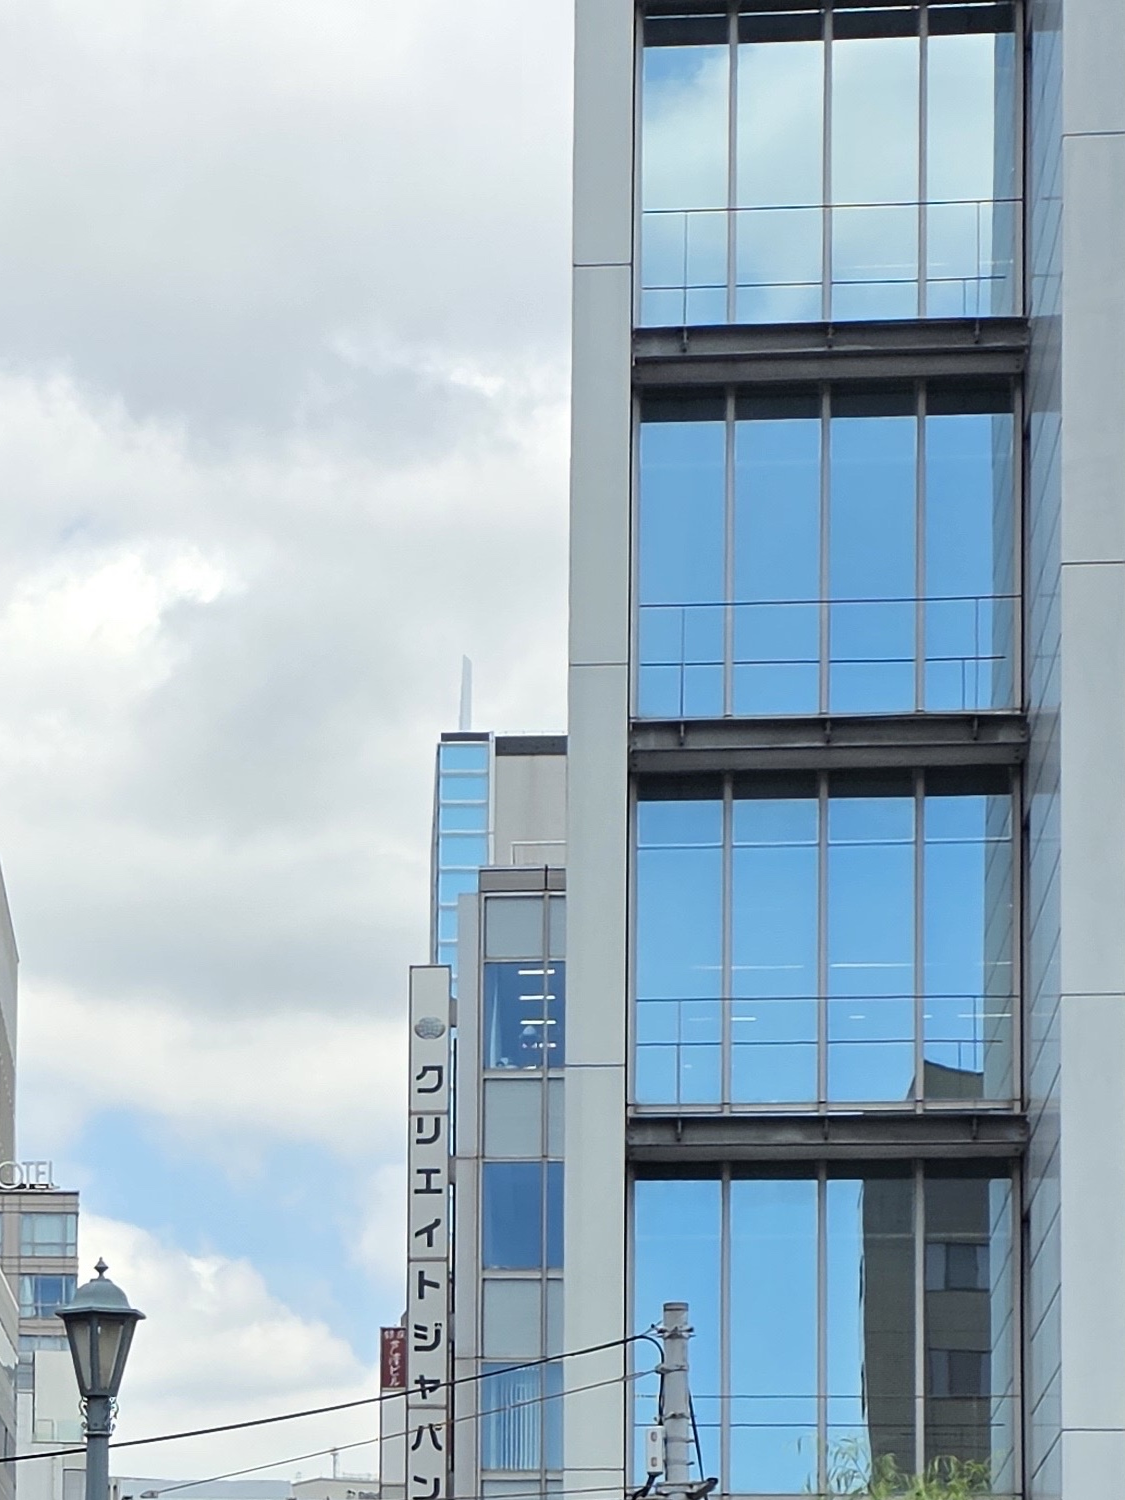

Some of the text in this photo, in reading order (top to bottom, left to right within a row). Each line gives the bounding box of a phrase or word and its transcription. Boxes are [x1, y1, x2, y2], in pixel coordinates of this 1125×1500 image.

[411, 1063, 444, 1500] クリエイトジャパン
